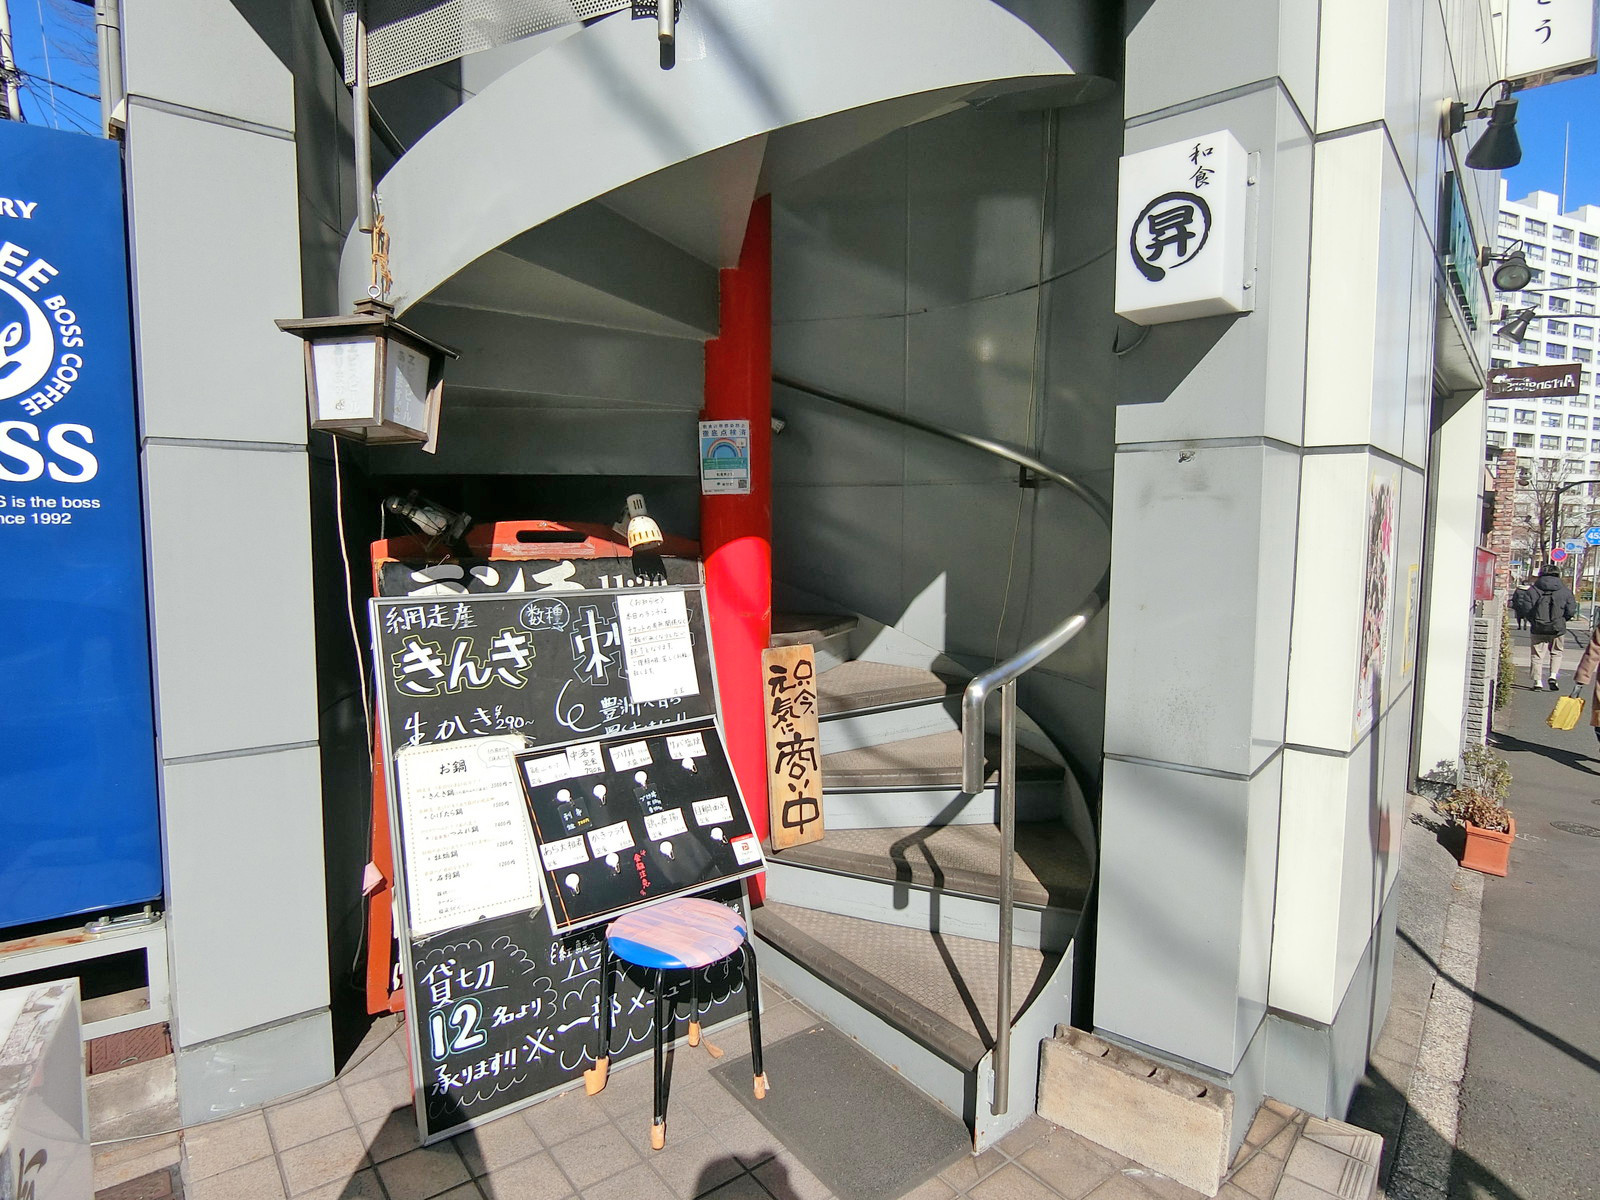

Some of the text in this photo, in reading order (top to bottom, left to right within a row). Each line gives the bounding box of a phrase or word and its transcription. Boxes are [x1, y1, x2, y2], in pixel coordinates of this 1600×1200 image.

[1188, 143, 1215, 189] 和食
[19, 294, 85, 417] BOSS COFFEE
[12, 495, 26, 508] is
[30, 495, 57, 509] the
[61, 496, 101, 509] boss
[31, 512, 72, 525] 1992
[386, 603, 478, 634] 網走産
[401, 629, 532, 693] きんき
[402, 706, 493, 746] 生かき
[440, 759, 467, 775] お鍋
[775, 732, 820, 835] 商い中
[420, 958, 495, 1008] 貸切
